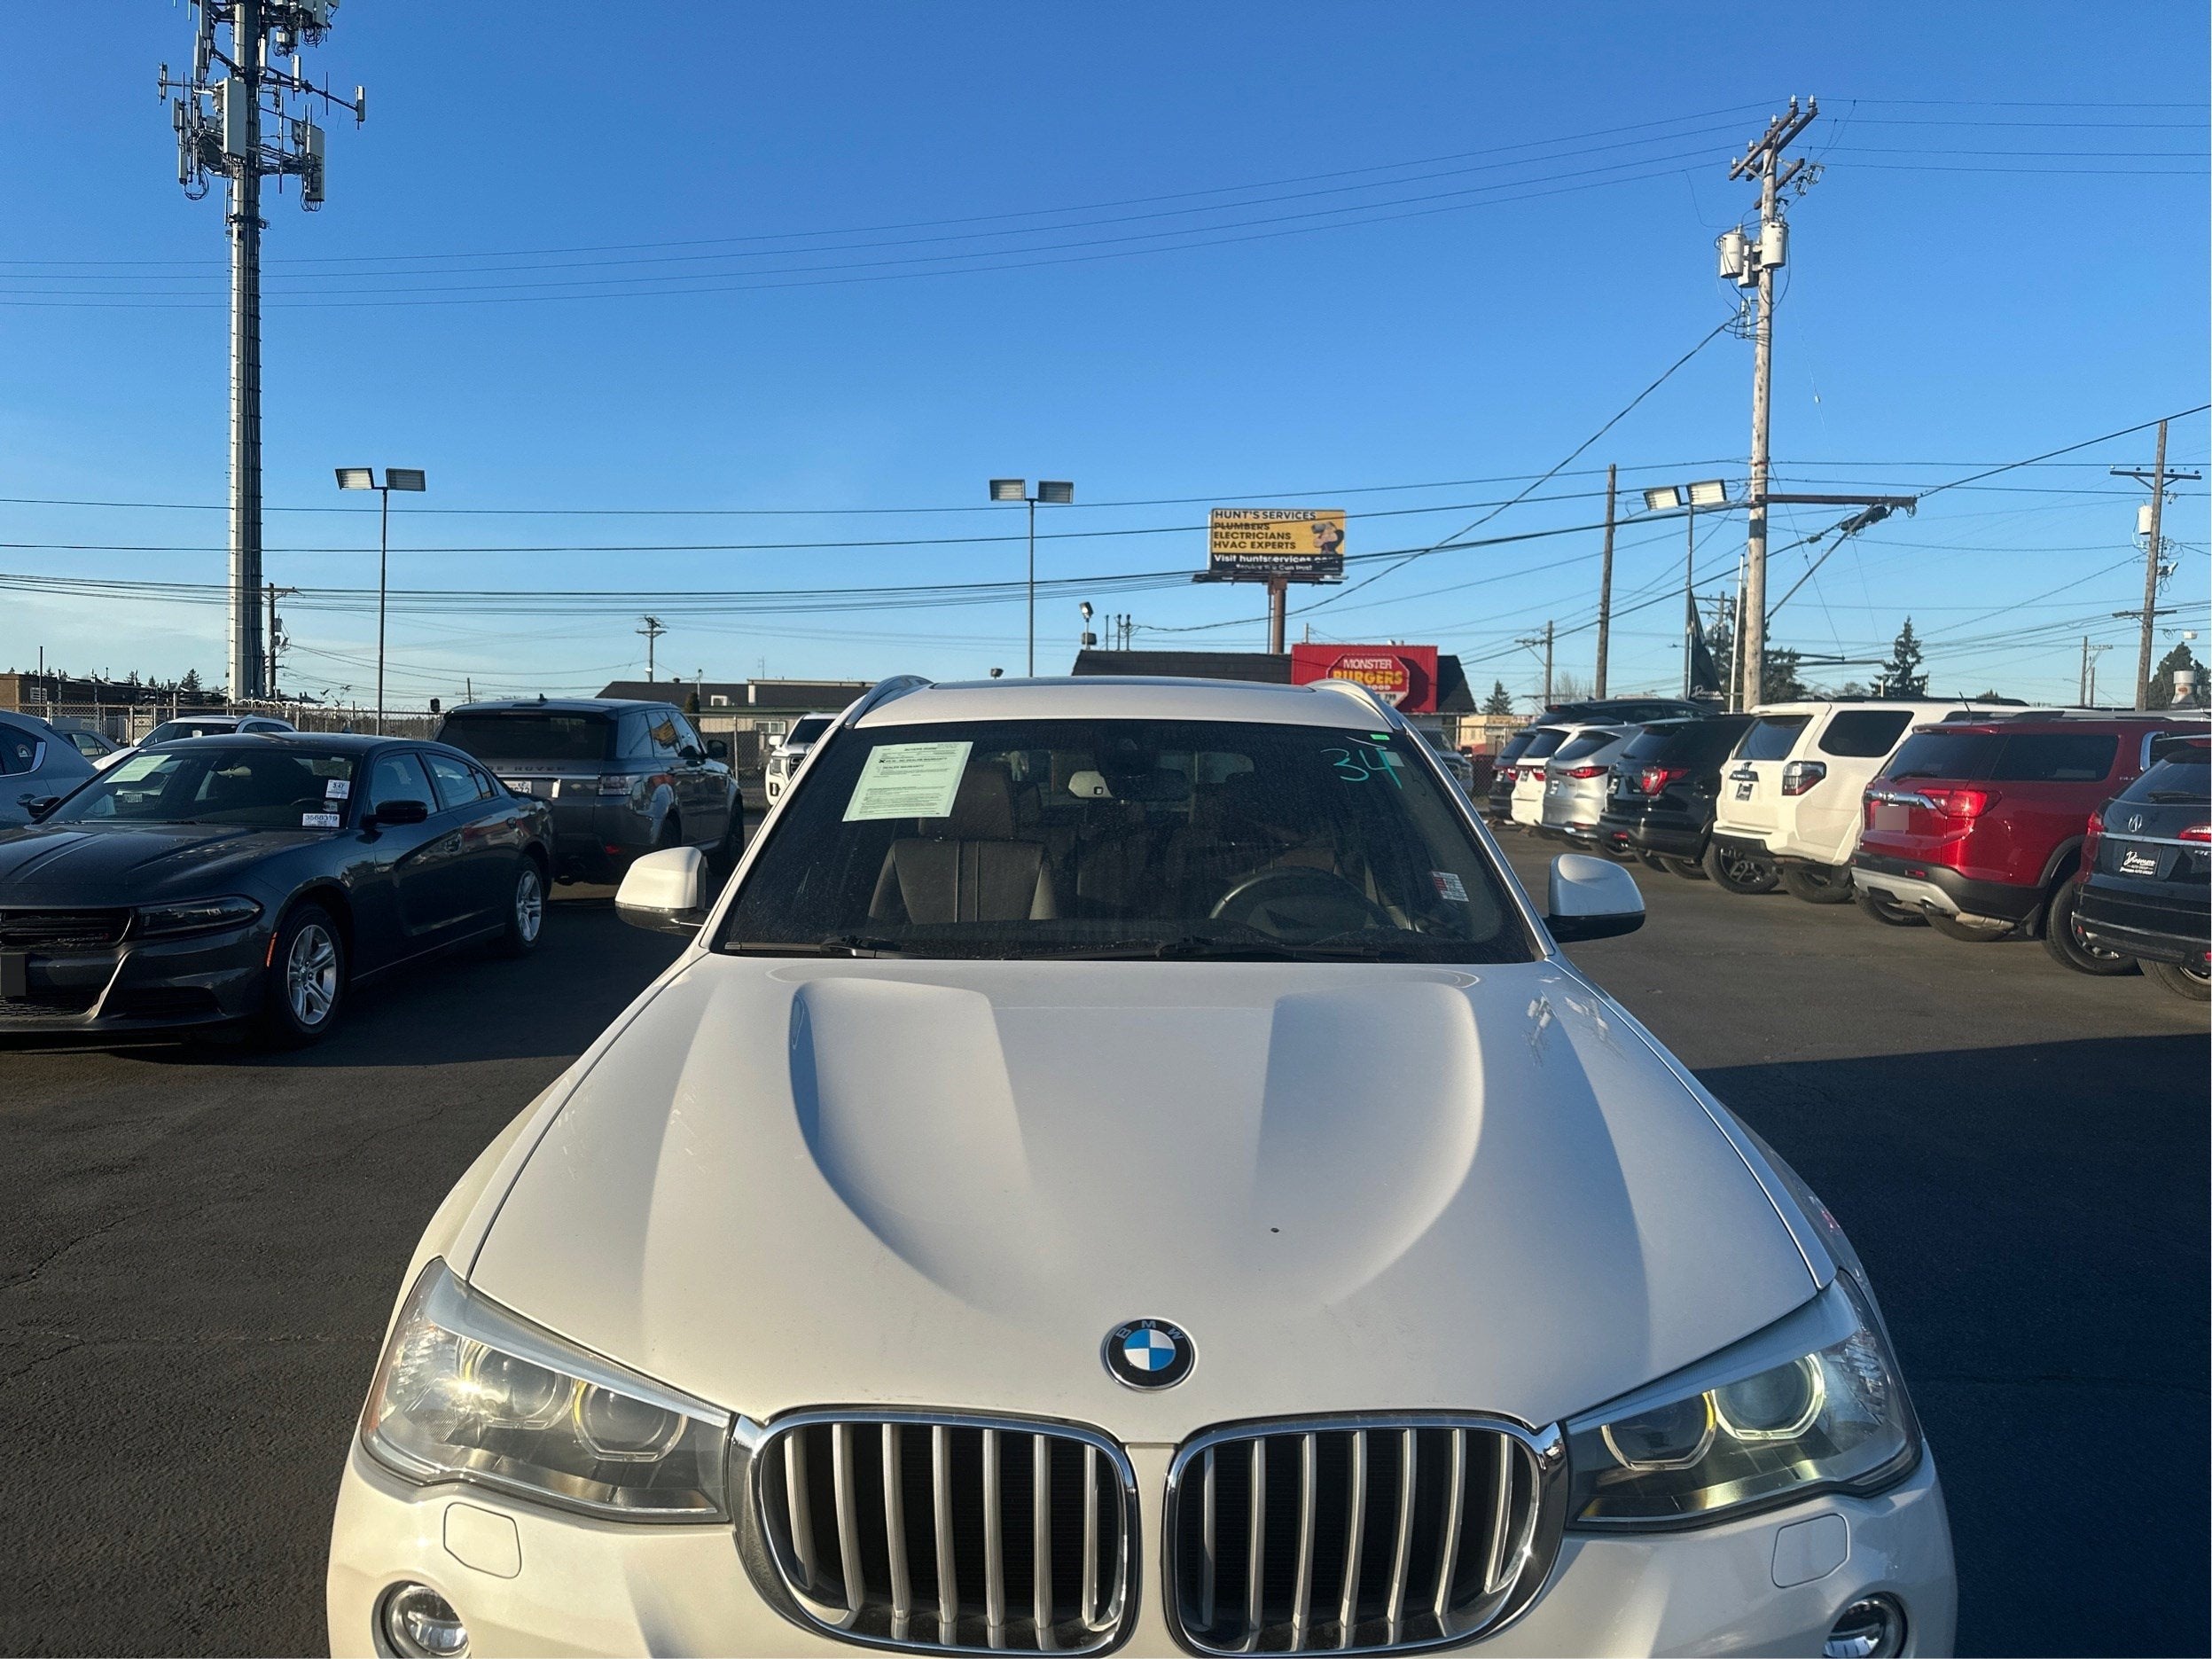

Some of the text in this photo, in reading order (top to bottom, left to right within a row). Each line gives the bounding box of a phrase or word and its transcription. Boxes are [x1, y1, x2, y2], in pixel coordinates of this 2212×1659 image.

[1215, 511, 1317, 520] HUNT'S SERVICES
[1214, 522, 1270, 531] PLUMBERS
[1214, 531, 1292, 540] ELECTRICIANS
[1250, 541, 1296, 550] EXPERTS
[1343, 659, 1393, 669] MONSTER
[1333, 670, 1403, 685] BURGERS
[1320, 747, 1403, 790] 34
[1115, 1320, 1184, 1341] BMW
